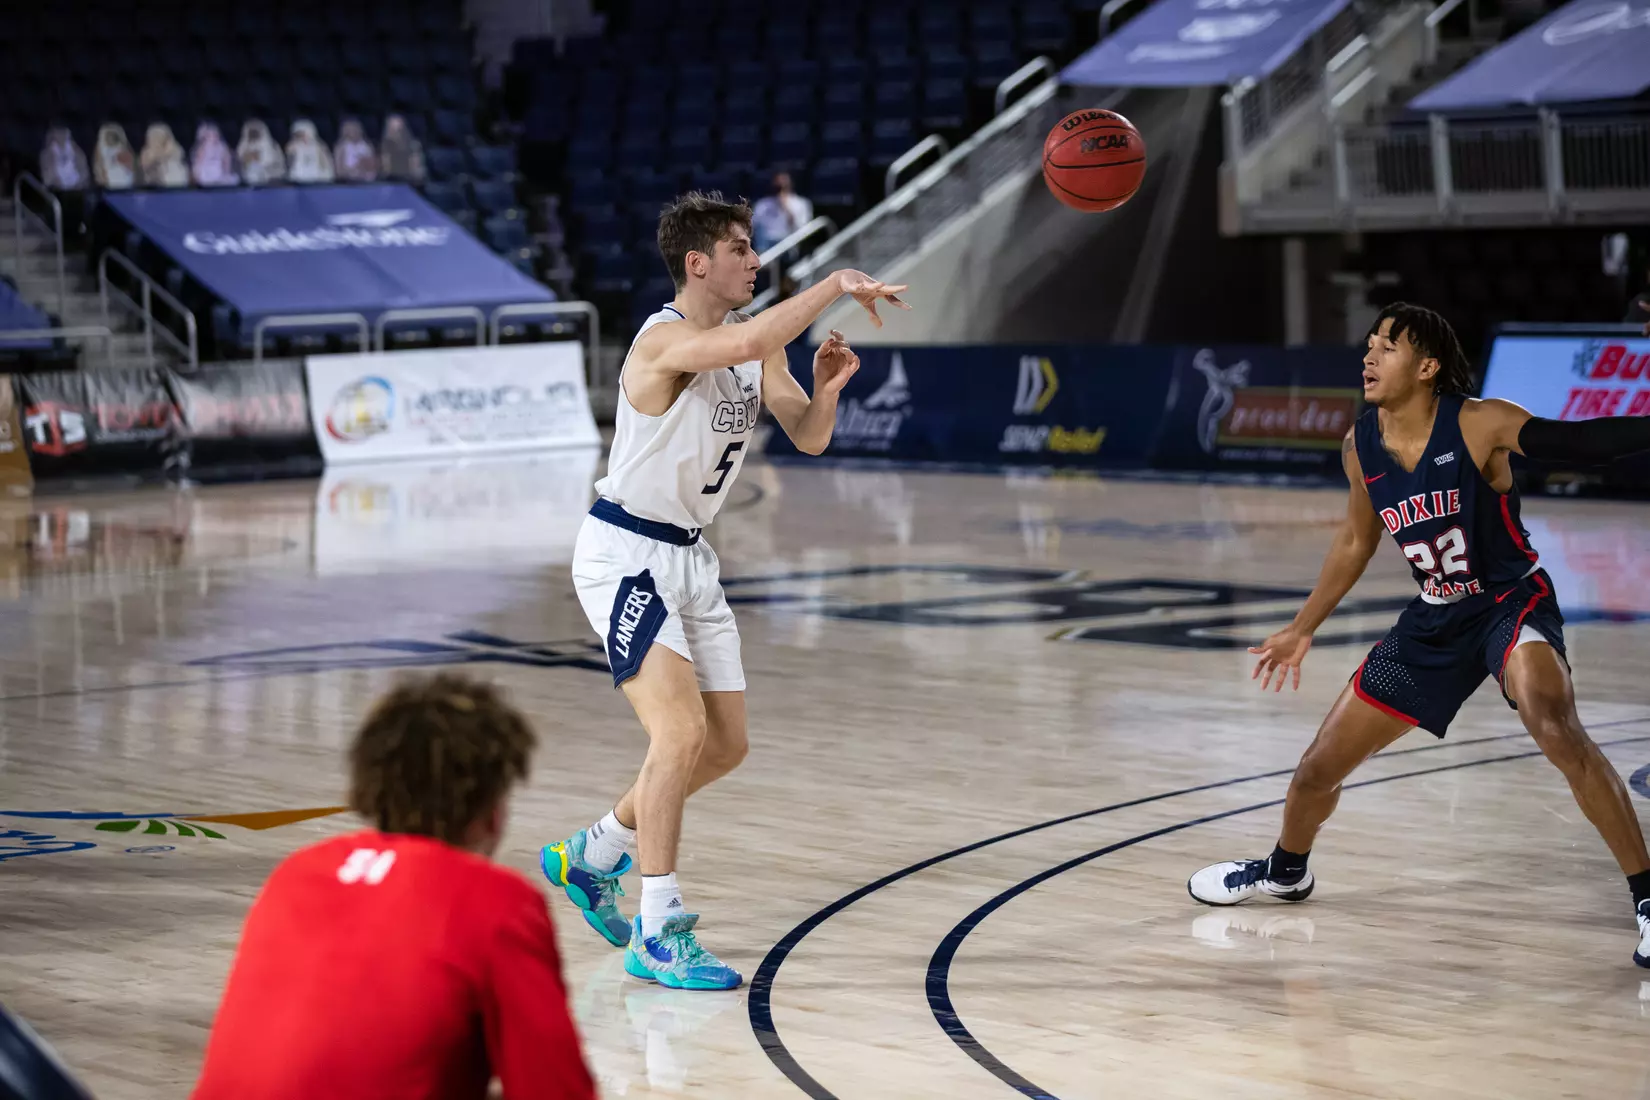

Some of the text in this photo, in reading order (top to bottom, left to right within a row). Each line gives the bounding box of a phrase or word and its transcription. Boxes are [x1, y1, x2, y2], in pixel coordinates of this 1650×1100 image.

[1081, 134, 1128, 153] NCAA
[711, 395, 759, 434] CBU
[701, 441, 744, 494] 5
[1434, 452, 1454, 466] WAC
[1379, 488, 1462, 535] DIXIE
[1401, 525, 1471, 581] 22
[615, 586, 653, 659] LANCERS
